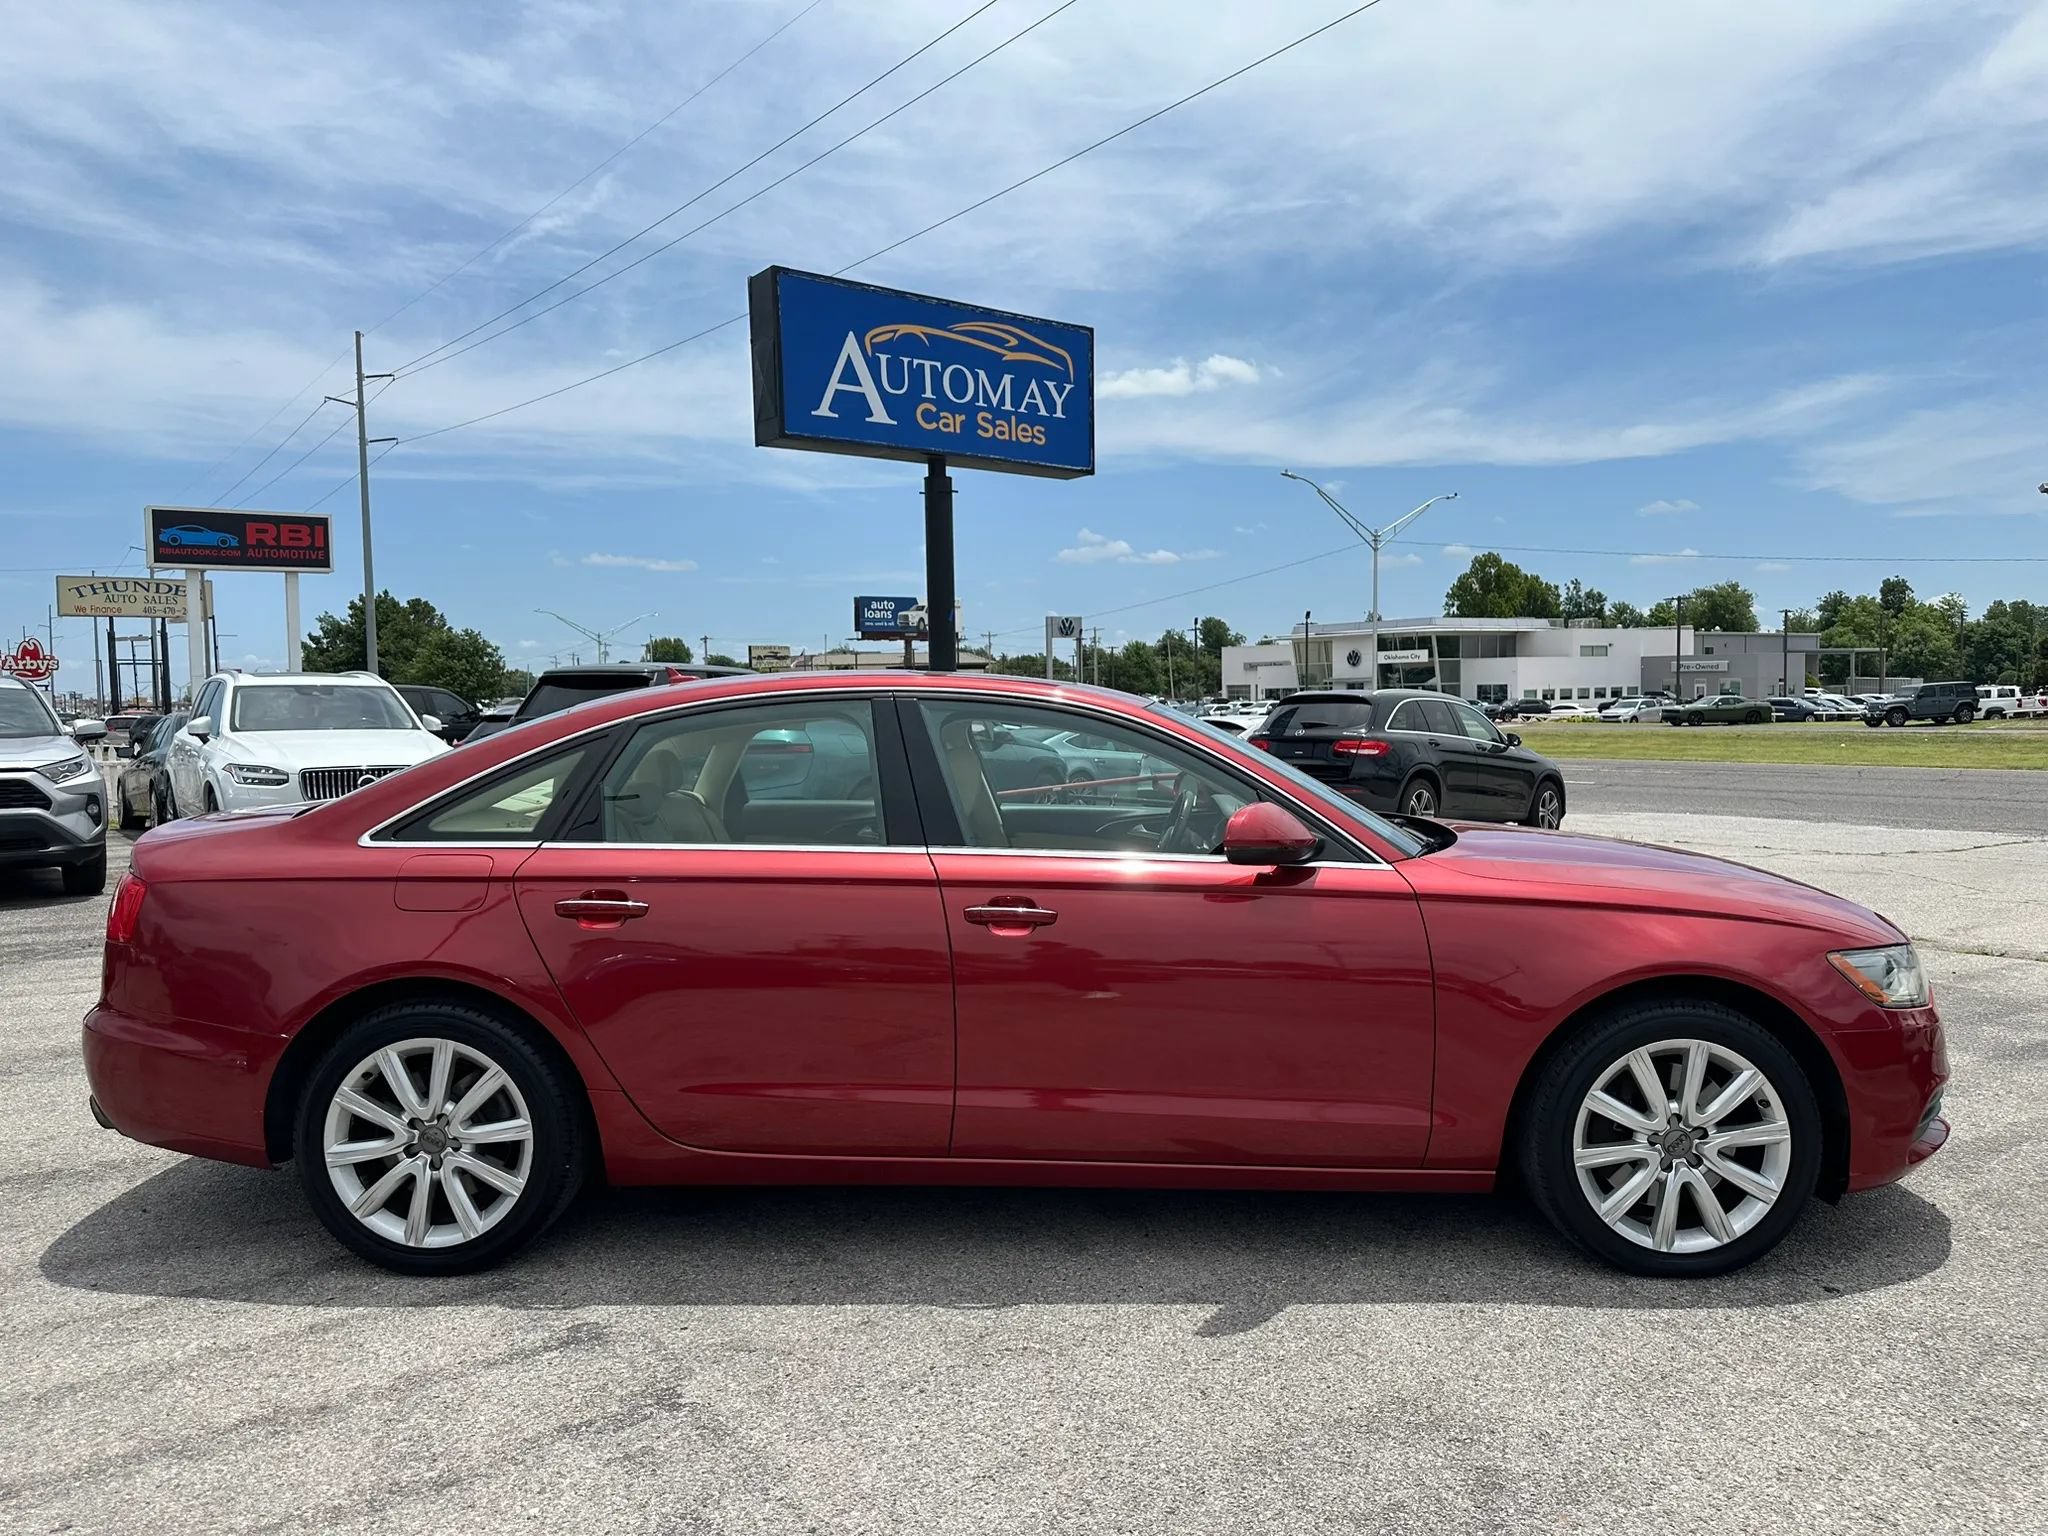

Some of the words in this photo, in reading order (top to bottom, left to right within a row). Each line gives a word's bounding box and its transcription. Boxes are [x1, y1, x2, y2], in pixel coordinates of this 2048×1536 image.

[811, 330, 1075, 426] AUTOMAY
[915, 402, 965, 435] Car
[976, 411, 1046, 446] Sales
[245, 521, 325, 548] RBI
[247, 547, 325, 560] AUTOMOTIVE
[68, 580, 188, 599] THUNDE
[104, 594, 137, 604] AUTO
[143, 594, 178, 605] SALES
[870, 600, 895, 610] auto
[73, 604, 87, 614] We
[90, 604, 123, 614] Finance
[142, 605, 188, 615] 405-470-2
[864, 608, 893, 619] loans
[1383, 653, 1409, 661] Oklahoma
[1410, 652, 1421, 660] City
